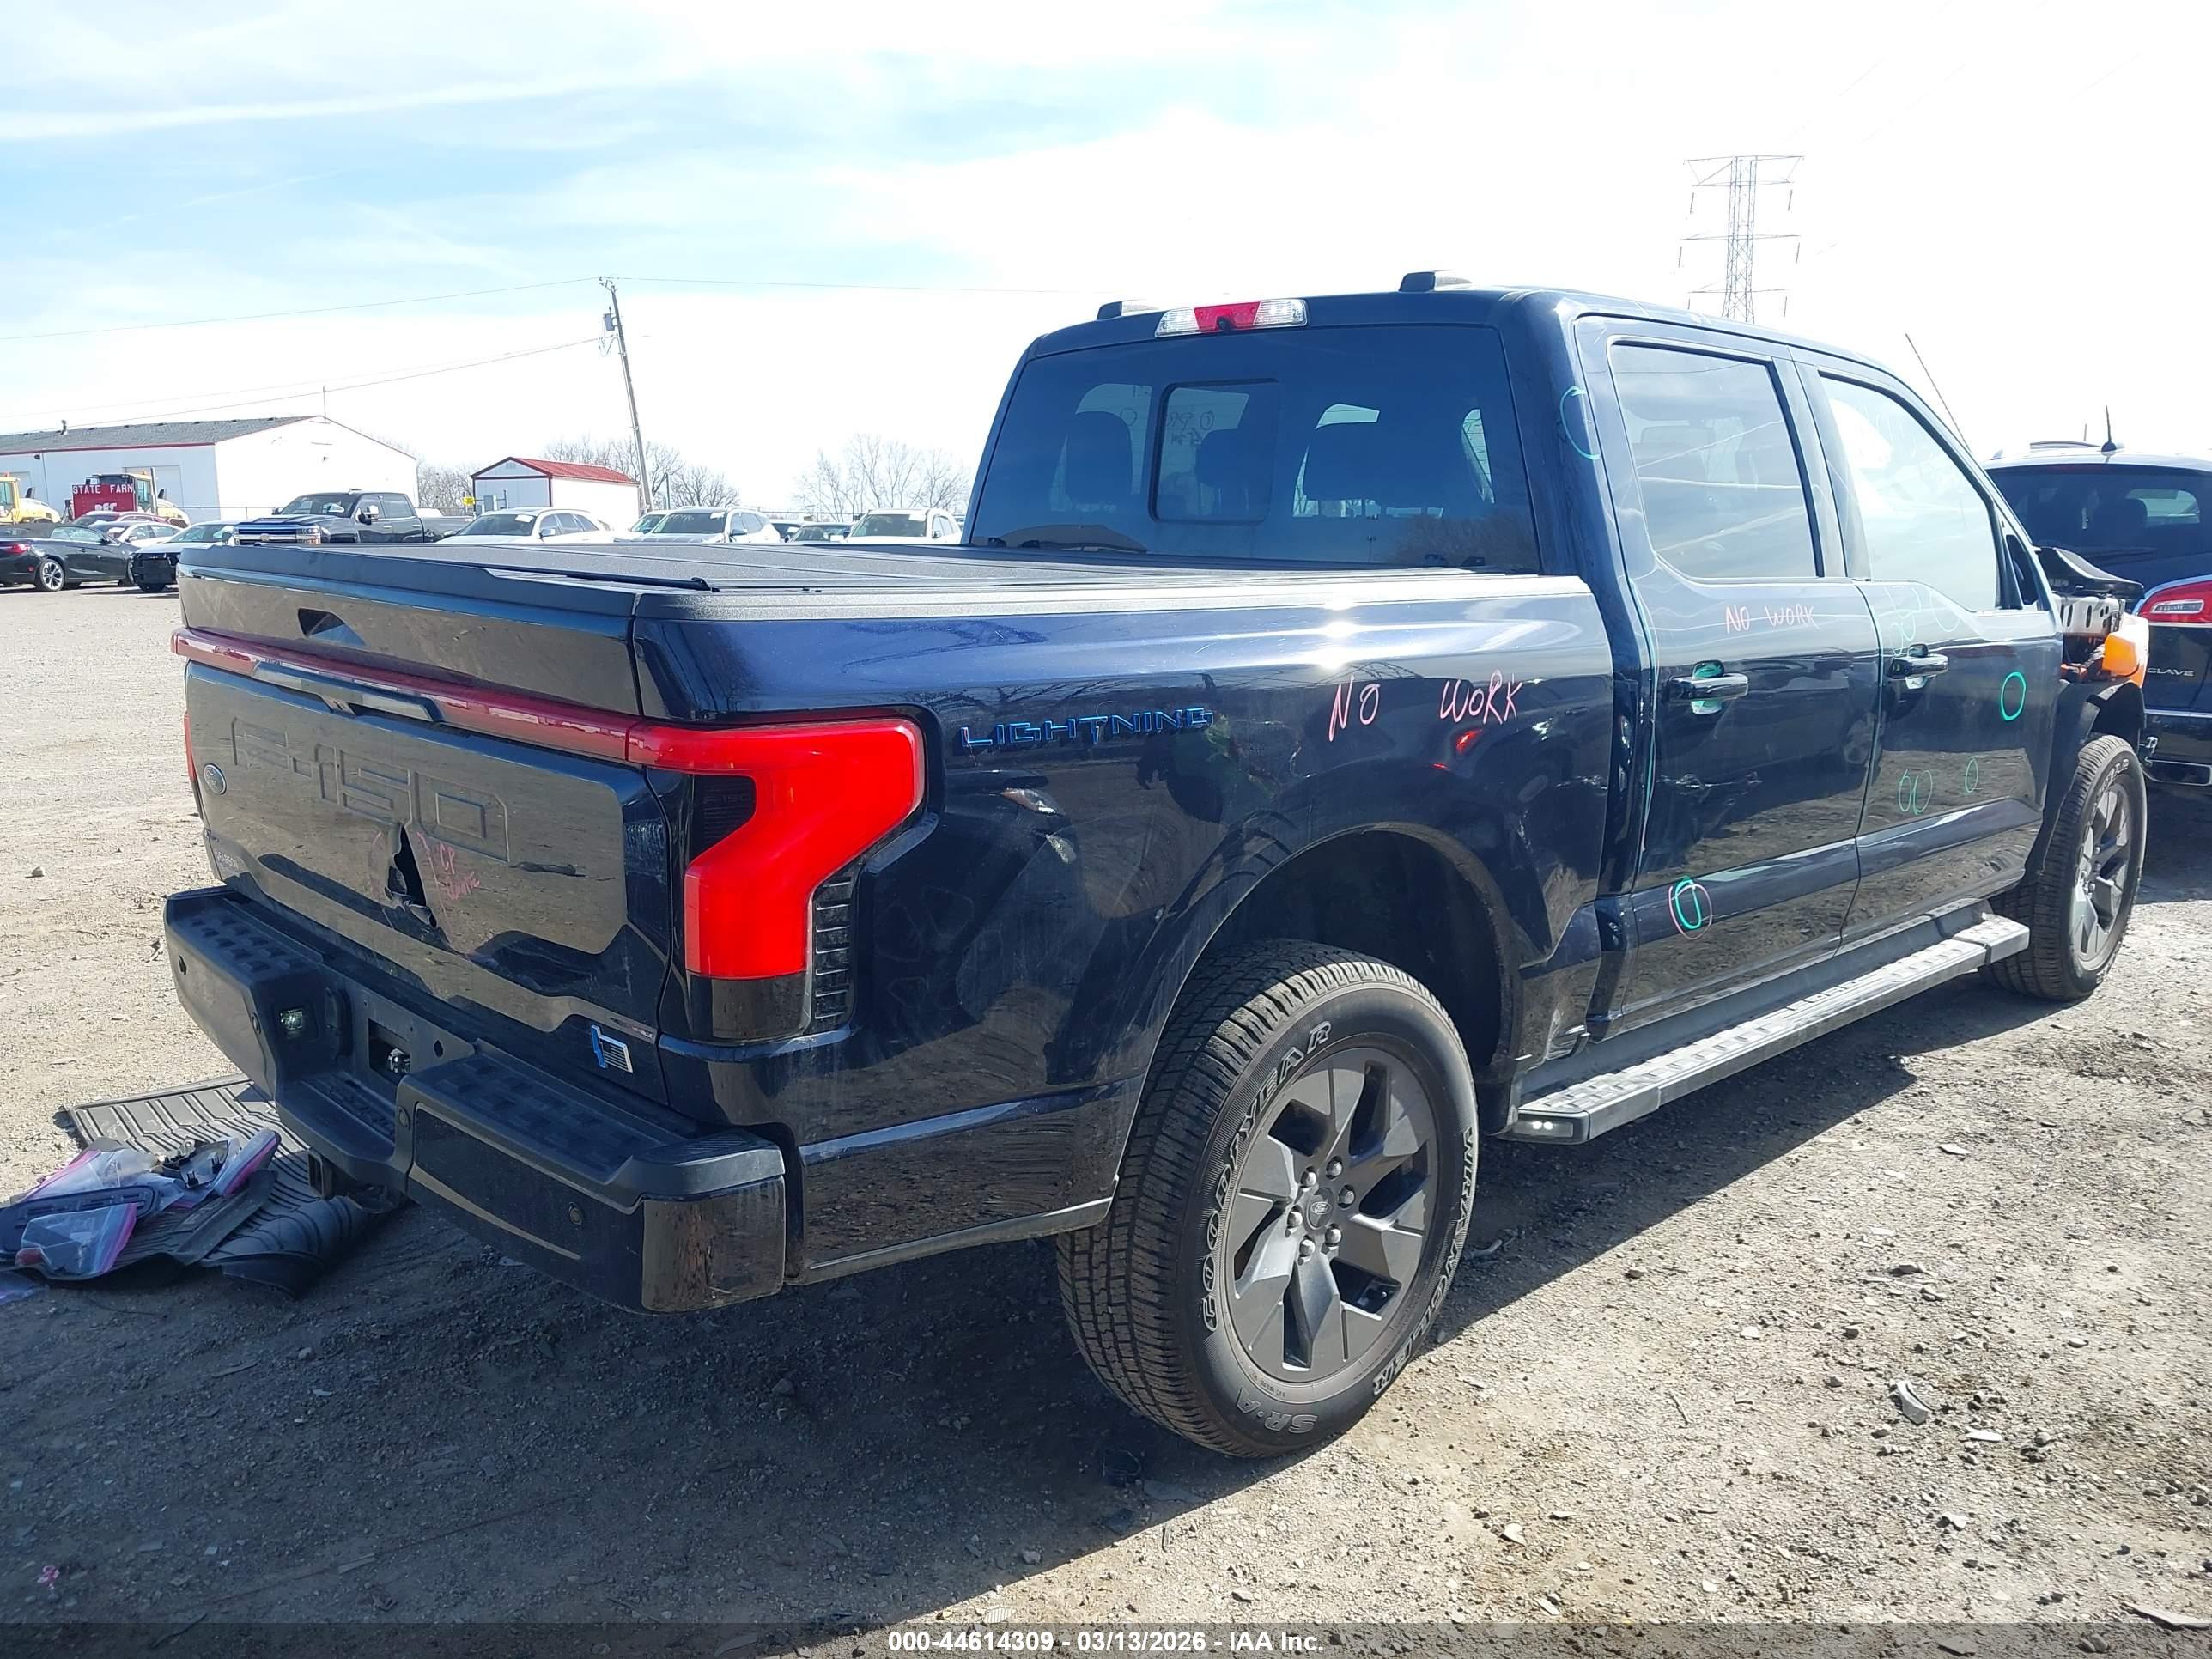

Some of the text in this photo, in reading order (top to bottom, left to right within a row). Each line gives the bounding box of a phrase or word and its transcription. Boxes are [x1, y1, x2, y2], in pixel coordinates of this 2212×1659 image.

[72, 483, 134, 495] STATE FARM
[1725, 603, 1820, 634] NO WORK
[2146, 666, 2196, 677] CLAVE
[1328, 668, 1523, 743] NO WORK
[960, 707, 1214, 748] LIGHTNING
[1201, 1019, 1331, 1332] GOODYEAR
[1372, 1125, 1474, 1395] WRANGLER
